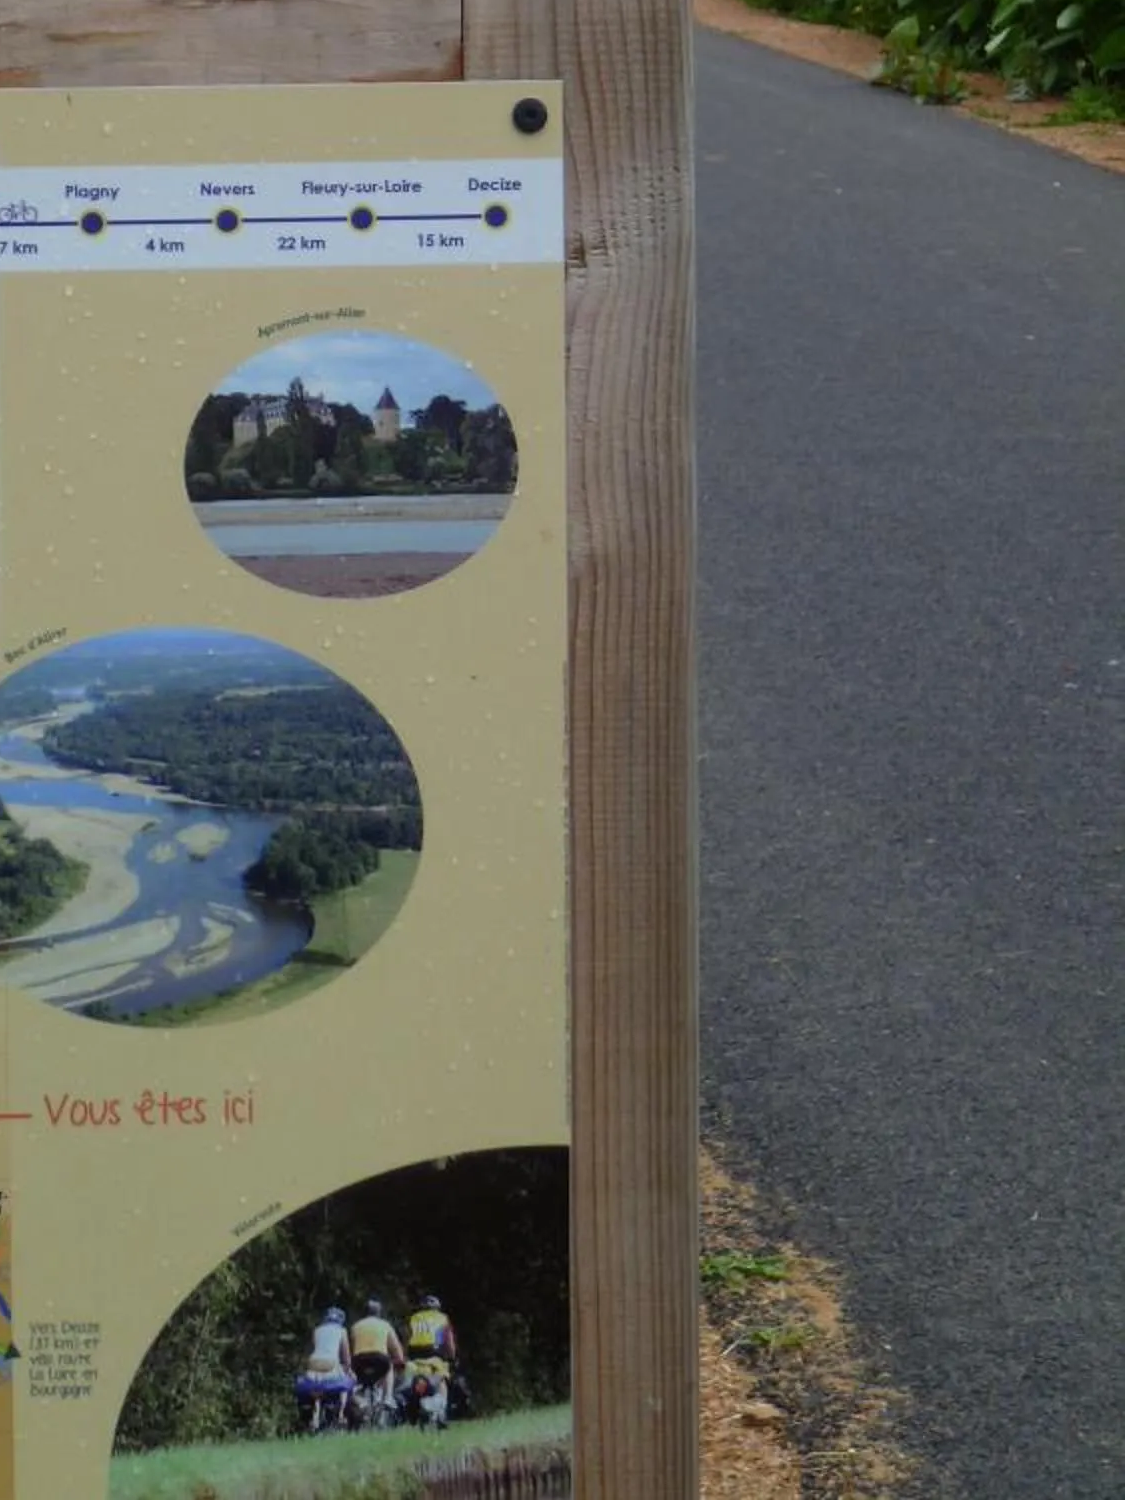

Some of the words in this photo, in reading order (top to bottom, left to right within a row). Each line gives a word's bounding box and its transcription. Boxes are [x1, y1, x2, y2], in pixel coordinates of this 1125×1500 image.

[200, 182, 255, 197] Nevers
[301, 180, 423, 198] Fleury-sur-Loire
[468, 177, 523, 192] Decize
[65, 183, 120, 202] Plagny
[11, 240, 39, 255] km
[145, 240, 155, 253] 4
[159, 238, 185, 253] km
[277, 237, 298, 251] 22
[301, 236, 327, 251] km
[417, 235, 436, 248] 15
[439, 234, 465, 248] km
[43, 1091, 122, 1127] Vous
[132, 1088, 208, 1126] êtes
[223, 1088, 256, 1126] ici
